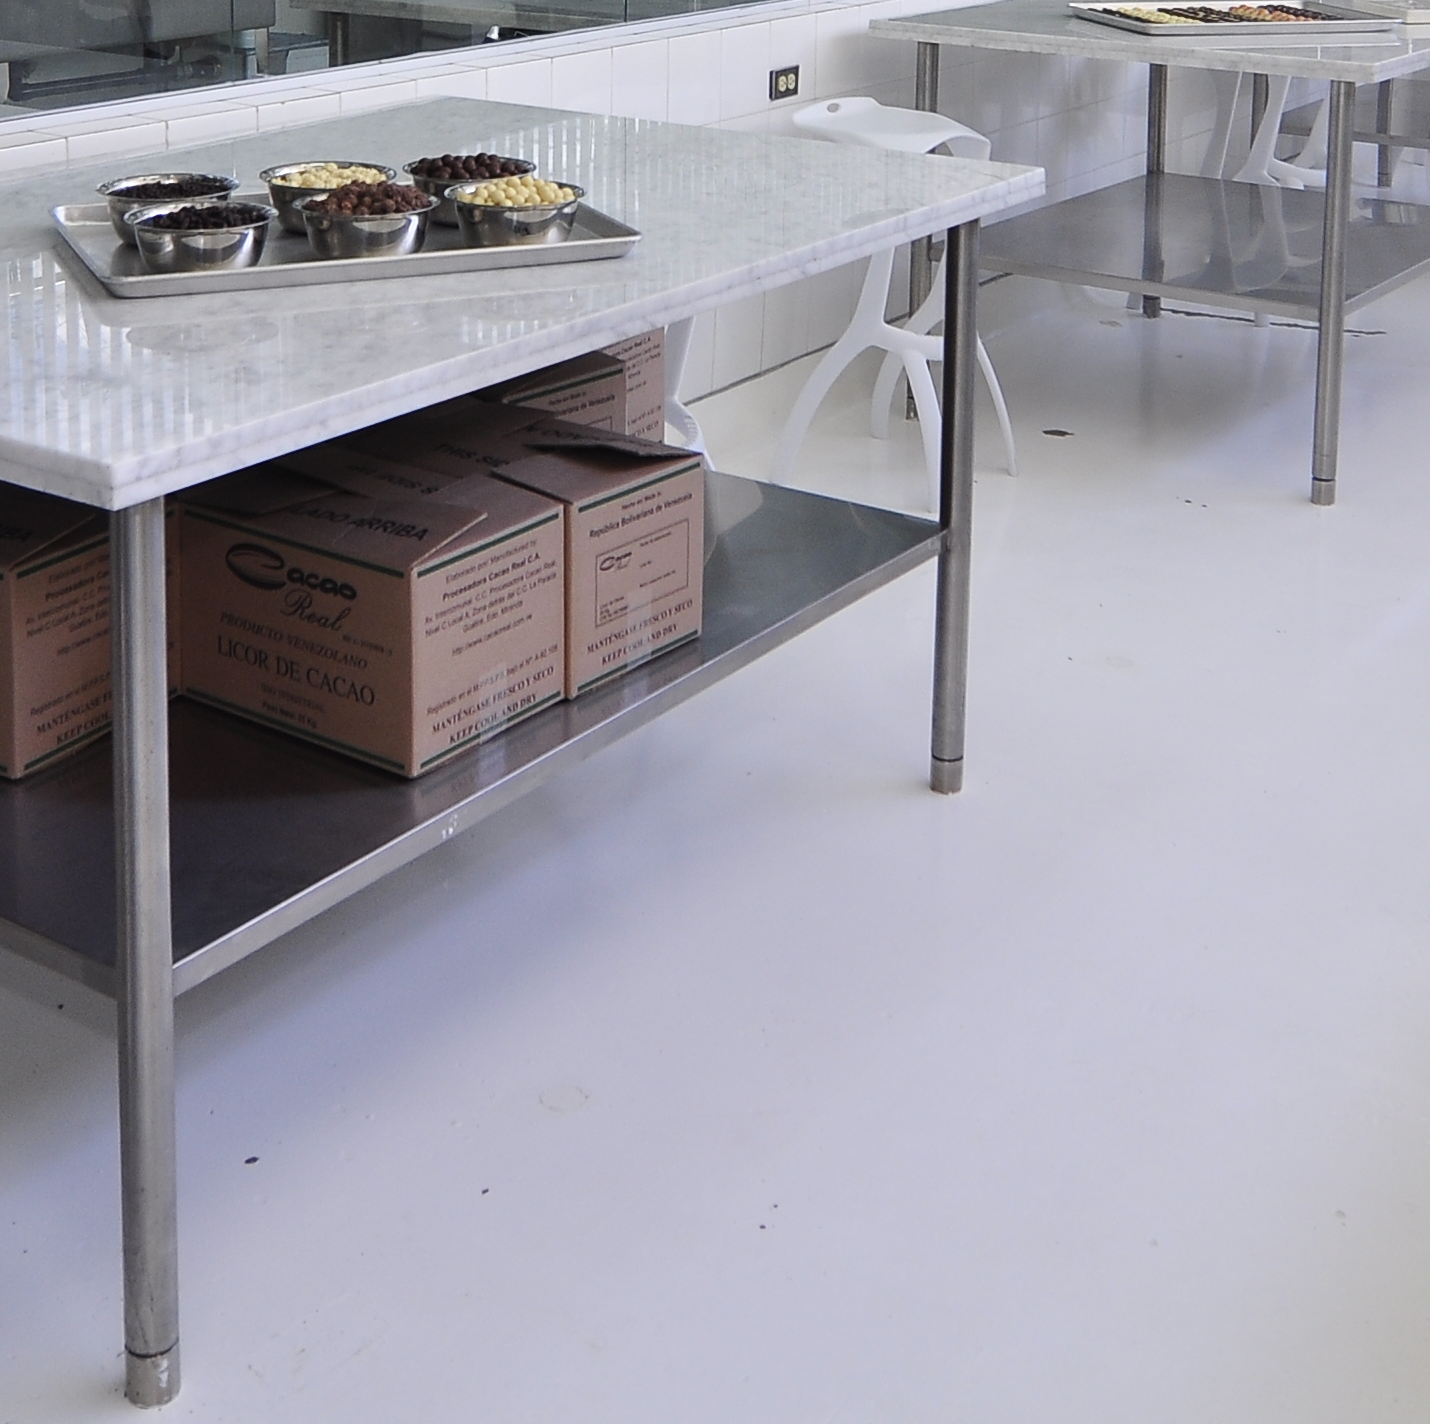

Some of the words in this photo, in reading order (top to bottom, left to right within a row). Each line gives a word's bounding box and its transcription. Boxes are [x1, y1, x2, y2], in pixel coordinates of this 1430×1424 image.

[347, 517, 429, 541] ARRIBA
[621, 508, 654, 526] Bolivariana
[655, 505, 663, 513] de
[663, 493, 693, 509] Venezuela
[225, 543, 357, 601] Cacao
[442, 576, 487, 602] Procesadora
[488, 567, 510, 581] Cacao
[511, 559, 526, 570] Real
[280, 590, 352, 630] Real
[221, 611, 283, 642] PRODUCTO
[286, 634, 367, 670] VENEZOLANO
[601, 647, 623, 665] KEEP
[662, 623, 677, 636] DRY
[218, 635, 268, 671] LICOR
[276, 656, 300, 682] DE
[306, 668, 375, 706] CACAO
[432, 696, 491, 734] MANTÉNGASE
[492, 680, 525, 704] FRESCO
[532, 666, 554, 683] SECO
[449, 725, 475, 744] KEEP
[475, 714, 498, 731] COOL
[501, 702, 519, 716] AND
[520, 693, 537, 708] DRY
[56, 723, 83, 744] KEEP
